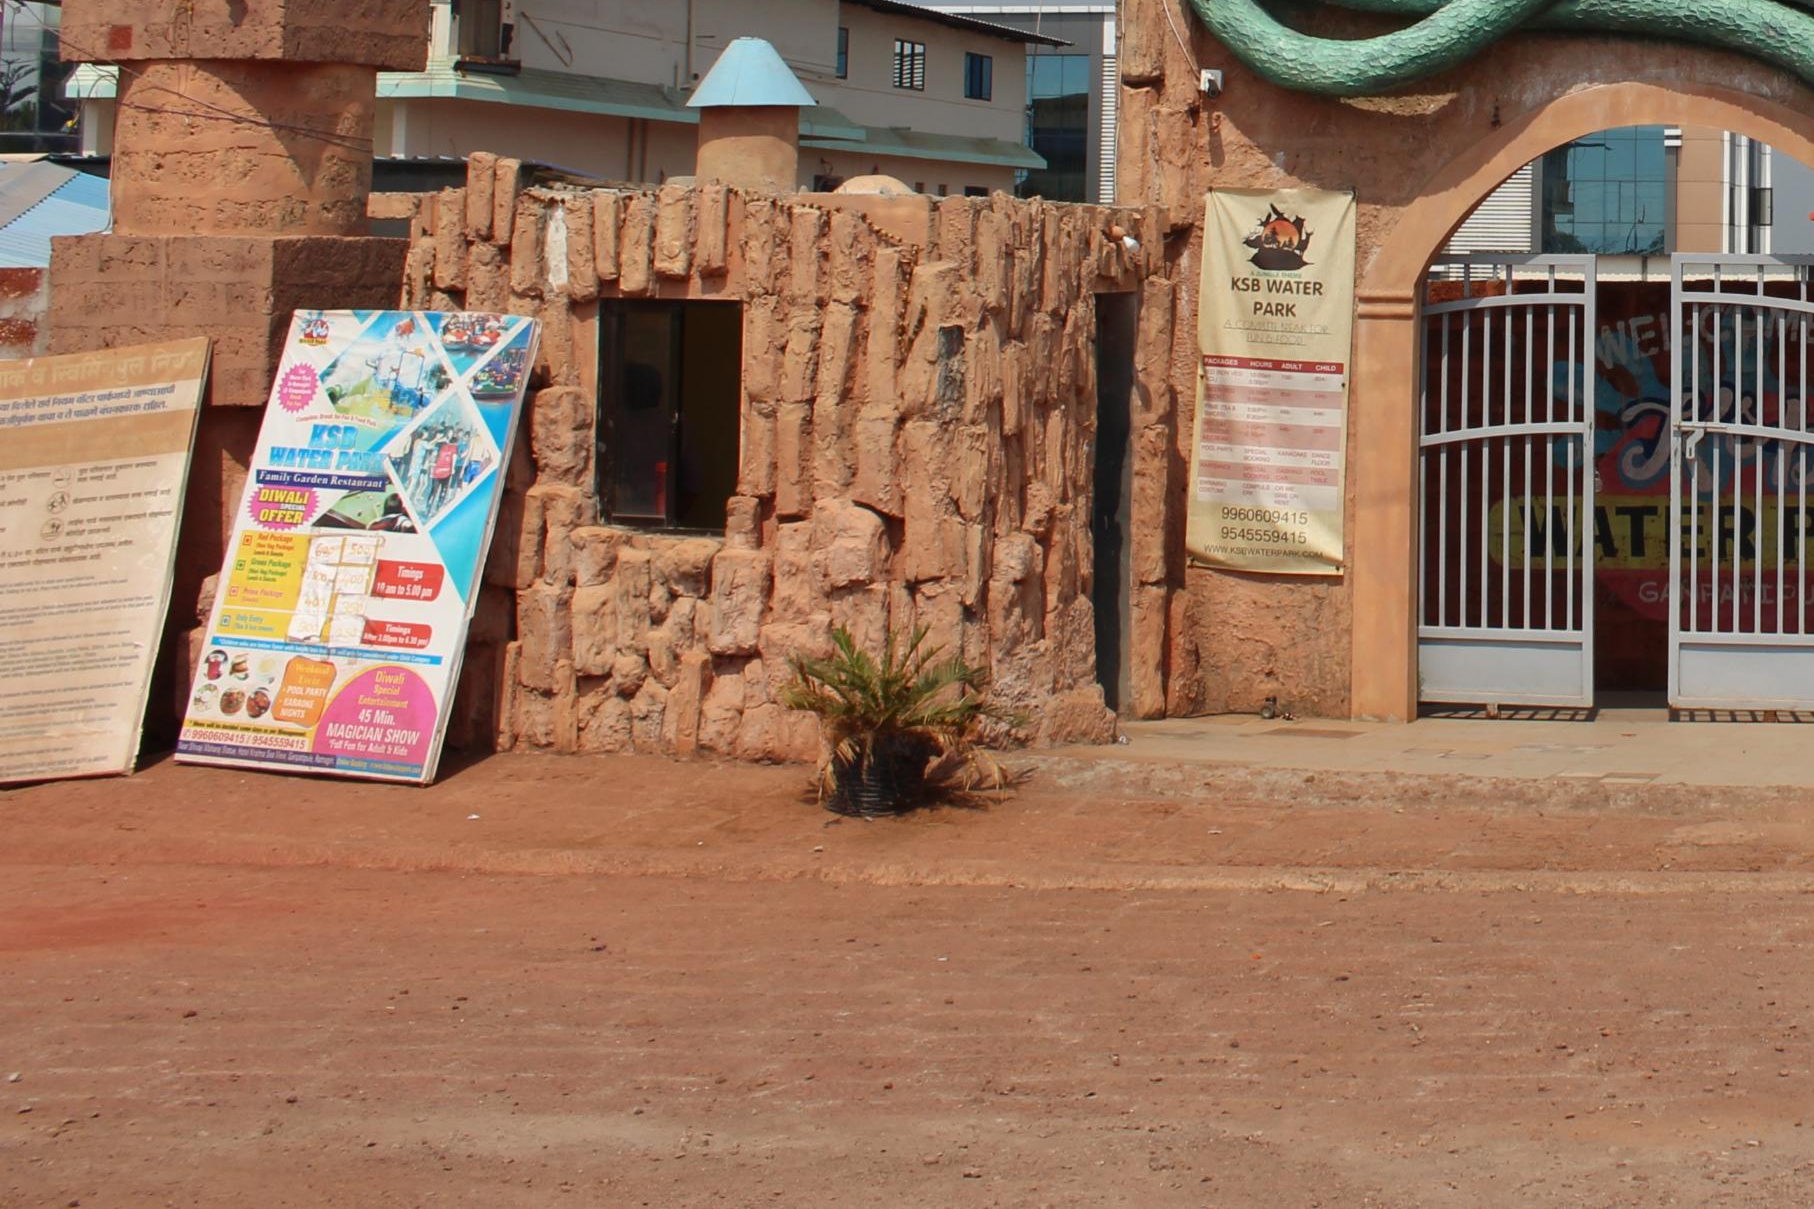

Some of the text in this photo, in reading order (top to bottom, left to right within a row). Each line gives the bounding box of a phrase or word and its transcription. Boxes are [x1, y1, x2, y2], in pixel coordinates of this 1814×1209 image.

[1231, 276, 1324, 296] KSB WATER
[1253, 301, 1297, 318] PARK
[1204, 357, 1239, 366] PACKAGES
[1249, 360, 1273, 368] HOURS
[1314, 364, 1337, 372] CHILD
[307, 423, 359, 450] KSB
[268, 445, 333, 469] WATER
[258, 470, 383, 488] Family Garden Restaurant
[258, 488, 310, 505] DIWALI
[259, 508, 305, 524] OFFER
[1221, 506, 1309, 525] 9960609415
[1220, 526, 1307, 544] 9545559415
[1518, 504, 1756, 559] WATER
[397, 565, 424, 581] Timings
[385, 585, 397, 594] am
[397, 585, 405, 595] to
[421, 588, 433, 599] pm
[385, 623, 411, 635] Timings
[375, 670, 406, 685] Diwali
[287, 685, 329, 697] POOL PARTY
[374, 684, 401, 696] Special
[283, 697, 315, 709] KARAOKE
[358, 694, 409, 709] Entertainment
[280, 708, 306, 719] NIGHTS
[358, 708, 396, 726] 45 Min.
[191, 729, 245, 744] 9960609415
[252, 735, 306, 750] 9545559415
[326, 723, 384, 742] MAGICIAN
[384, 728, 420, 745] SHOW
[343, 741, 356, 751] Fun
[357, 741, 367, 752] for
[367, 743, 386, 754] Adult
[393, 746, 408, 756] Kids
